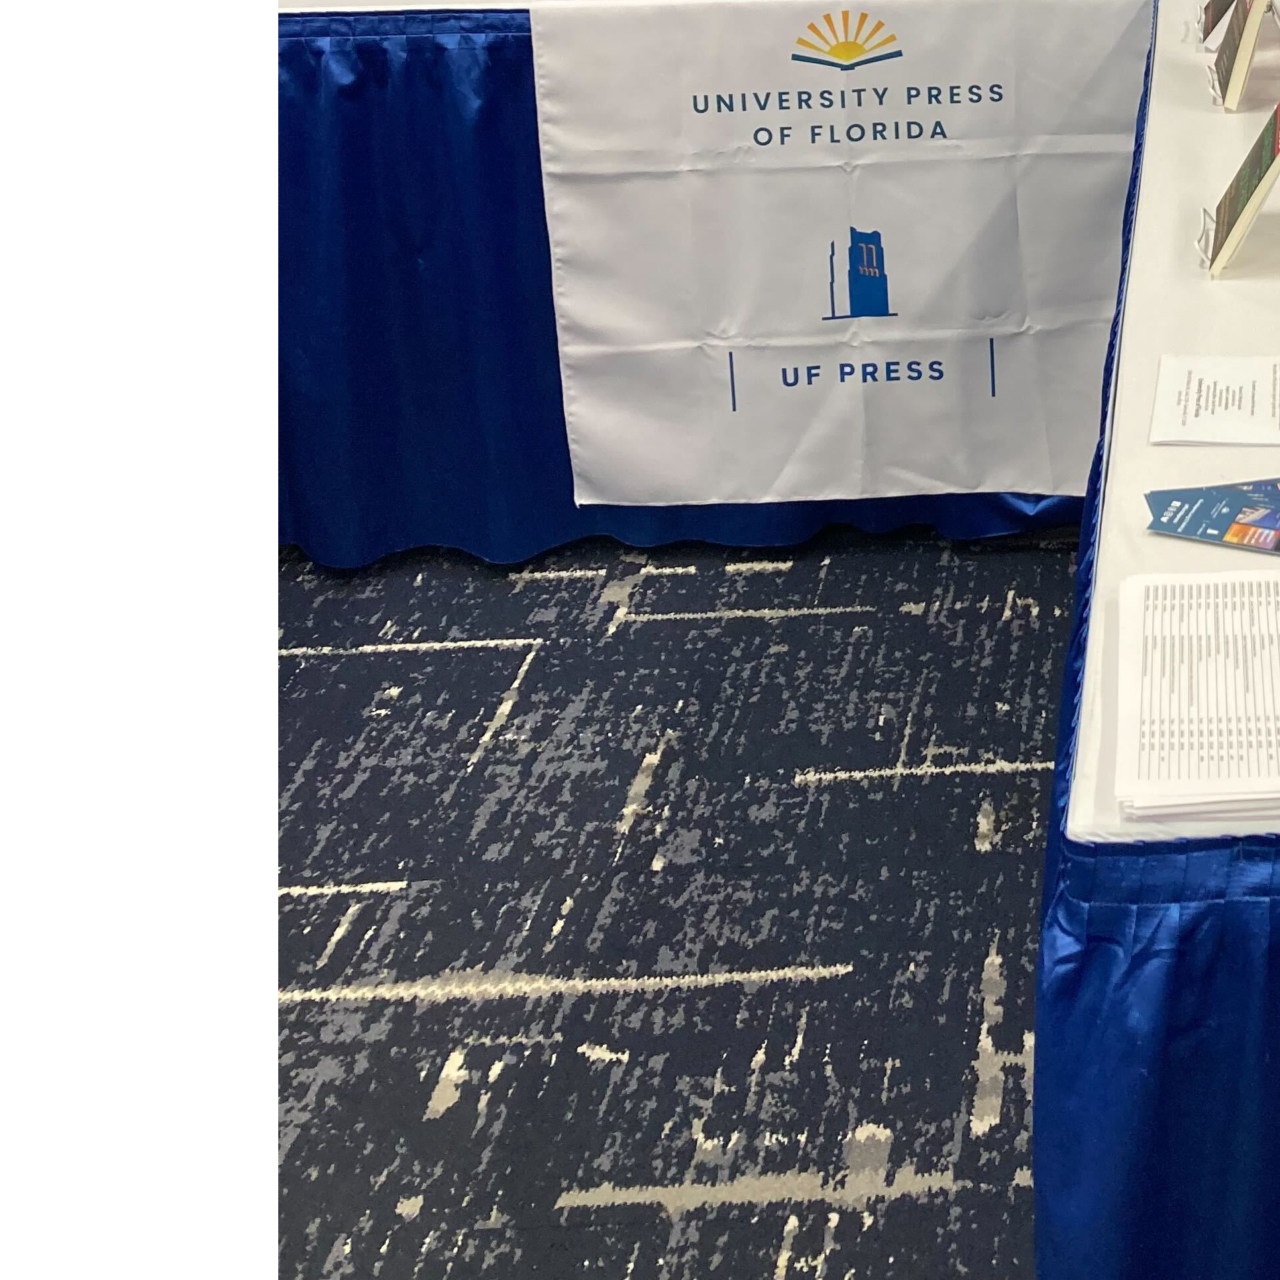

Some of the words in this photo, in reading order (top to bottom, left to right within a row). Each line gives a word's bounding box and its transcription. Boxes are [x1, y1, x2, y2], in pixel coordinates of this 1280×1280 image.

[693, 87, 889, 113] UNIVERSITY
[907, 83, 1005, 105] PRESS
[753, 126, 793, 146] OF
[810, 121, 947, 144] FLORIDA
[781, 366, 821, 387] UF
[839, 361, 944, 383] PRESS
